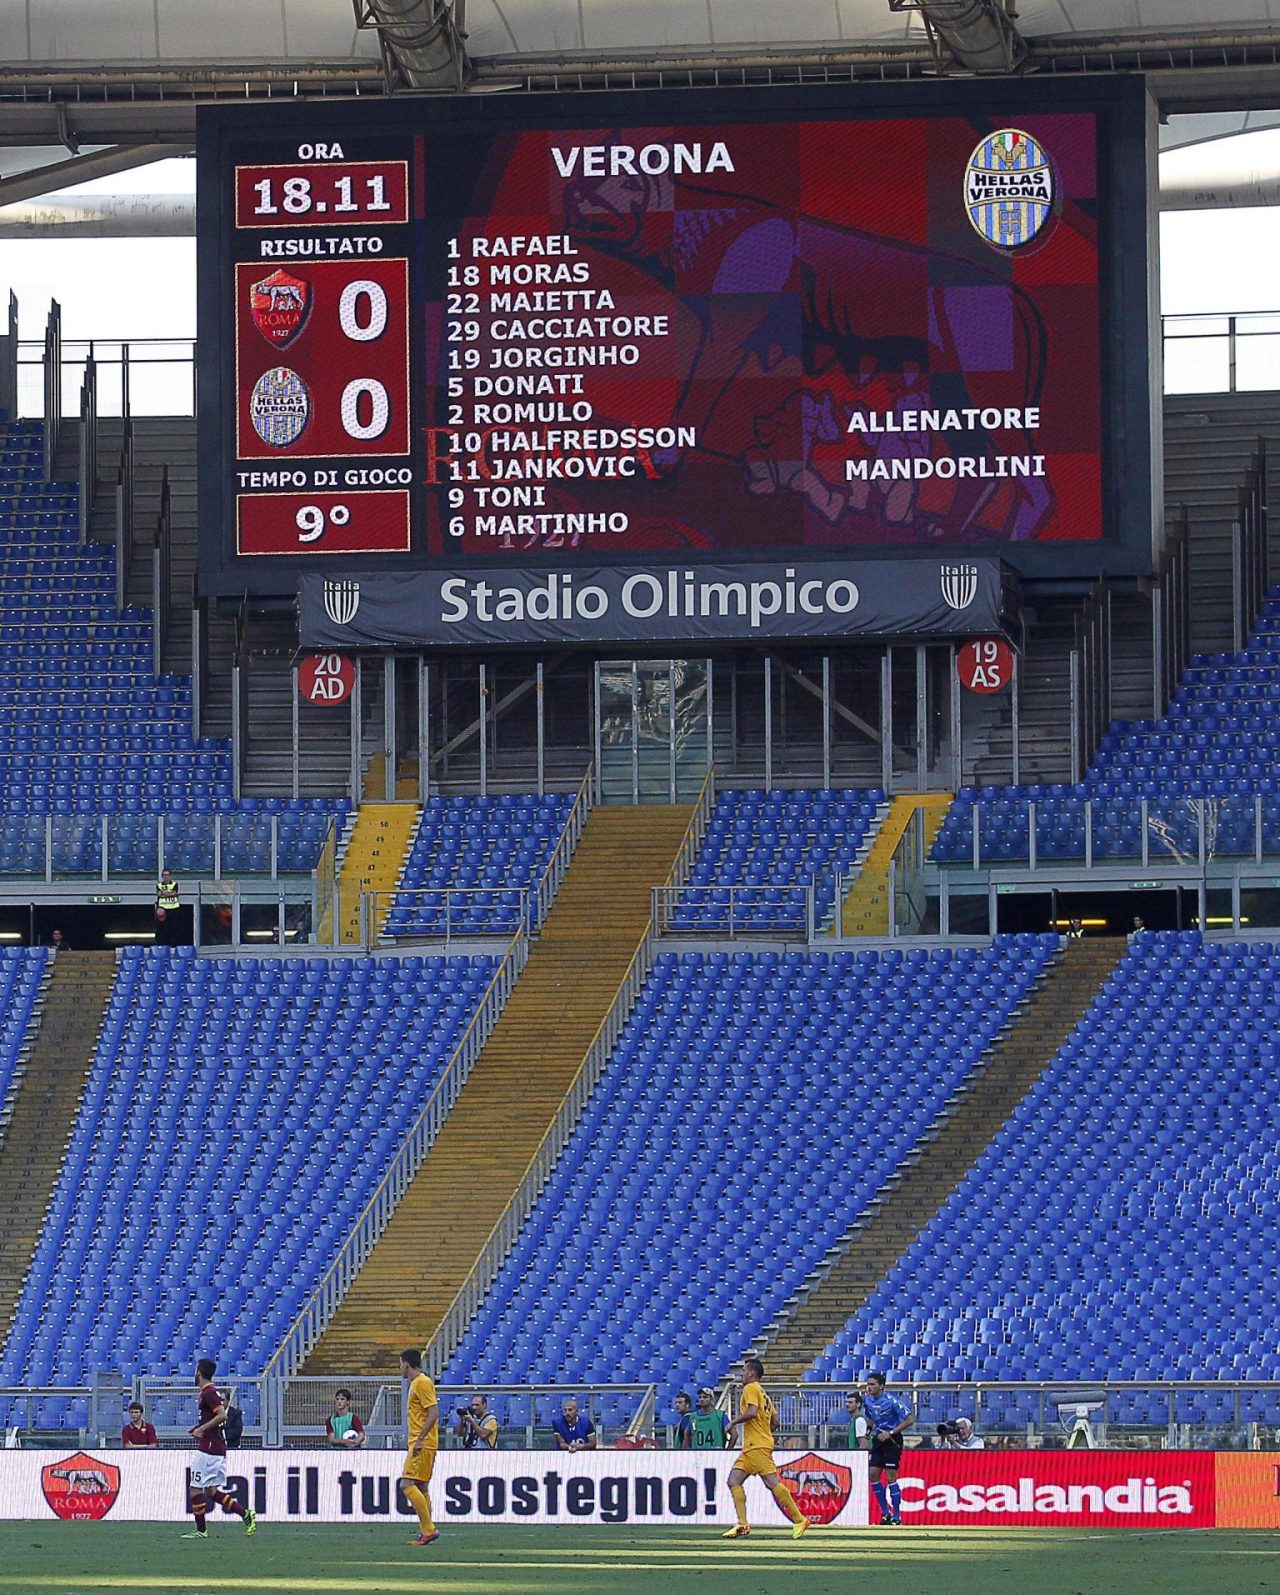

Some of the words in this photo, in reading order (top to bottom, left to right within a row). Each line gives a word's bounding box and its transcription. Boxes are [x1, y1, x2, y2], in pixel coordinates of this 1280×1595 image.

[298, 143, 344, 159] ORA
[551, 142, 735, 178] VERONA
[974, 171, 1044, 187] HELLAS
[254, 175, 391, 215] 18.11
[969, 185, 1049, 201] VERONA
[260, 237, 383, 256] RISULTATO
[447, 239, 461, 259] 1
[472, 235, 578, 257] RAFAEL
[447, 266, 480, 287] 18
[490, 263, 590, 285] MORAS
[338, 279, 387, 342] 0
[447, 293, 480, 314] 22
[490, 289, 615, 312] MAIETTA
[447, 321, 480, 341] 29
[490, 316, 669, 341] CACCIATORE
[447, 349, 480, 370] 19
[489, 345, 640, 369] JORGINHO
[448, 377, 463, 397] 5
[474, 374, 584, 397] DONATI
[255, 404, 307, 416] VERONA
[257, 396, 303, 407] HELLAS
[340, 378, 390, 440] 0
[448, 405, 463, 424] 2
[474, 401, 593, 424] ROMULO
[847, 407, 1041, 433] ALLENATORE
[448, 432, 481, 453] 10
[491, 427, 696, 452] HALFREDSSON
[237, 471, 307, 489] TEMPO
[314, 469, 338, 487] DI
[345, 468, 413, 486] GIOCO
[449, 460, 480, 480] 11
[490, 456, 636, 480] JANKOVIC
[846, 455, 1046, 481] MANDORLINI
[448, 488, 464, 508] 9
[474, 486, 546, 508] TONI
[448, 516, 465, 536] 6
[475, 512, 629, 536] MARTINHO
[941, 565, 978, 575] Italia
[324, 581, 360, 592] Italia
[440, 573, 609, 622] Stadio
[621, 569, 859, 627] Olimpico
[971, 640, 998, 663] 19
[314, 654, 341, 675] 20
[970, 664, 1001, 687] AS
[311, 677, 345, 700] AD
[696, 1429, 715, 1447] 04
[191, 1471, 202, 1483] 15
[54, 1497, 108, 1509] ROMA
[287, 1466, 319, 1515] il
[445, 1467, 717, 1522] sostegno!
[797, 1499, 838, 1511] OMA
[898, 1476, 1194, 1515] Casalandia
